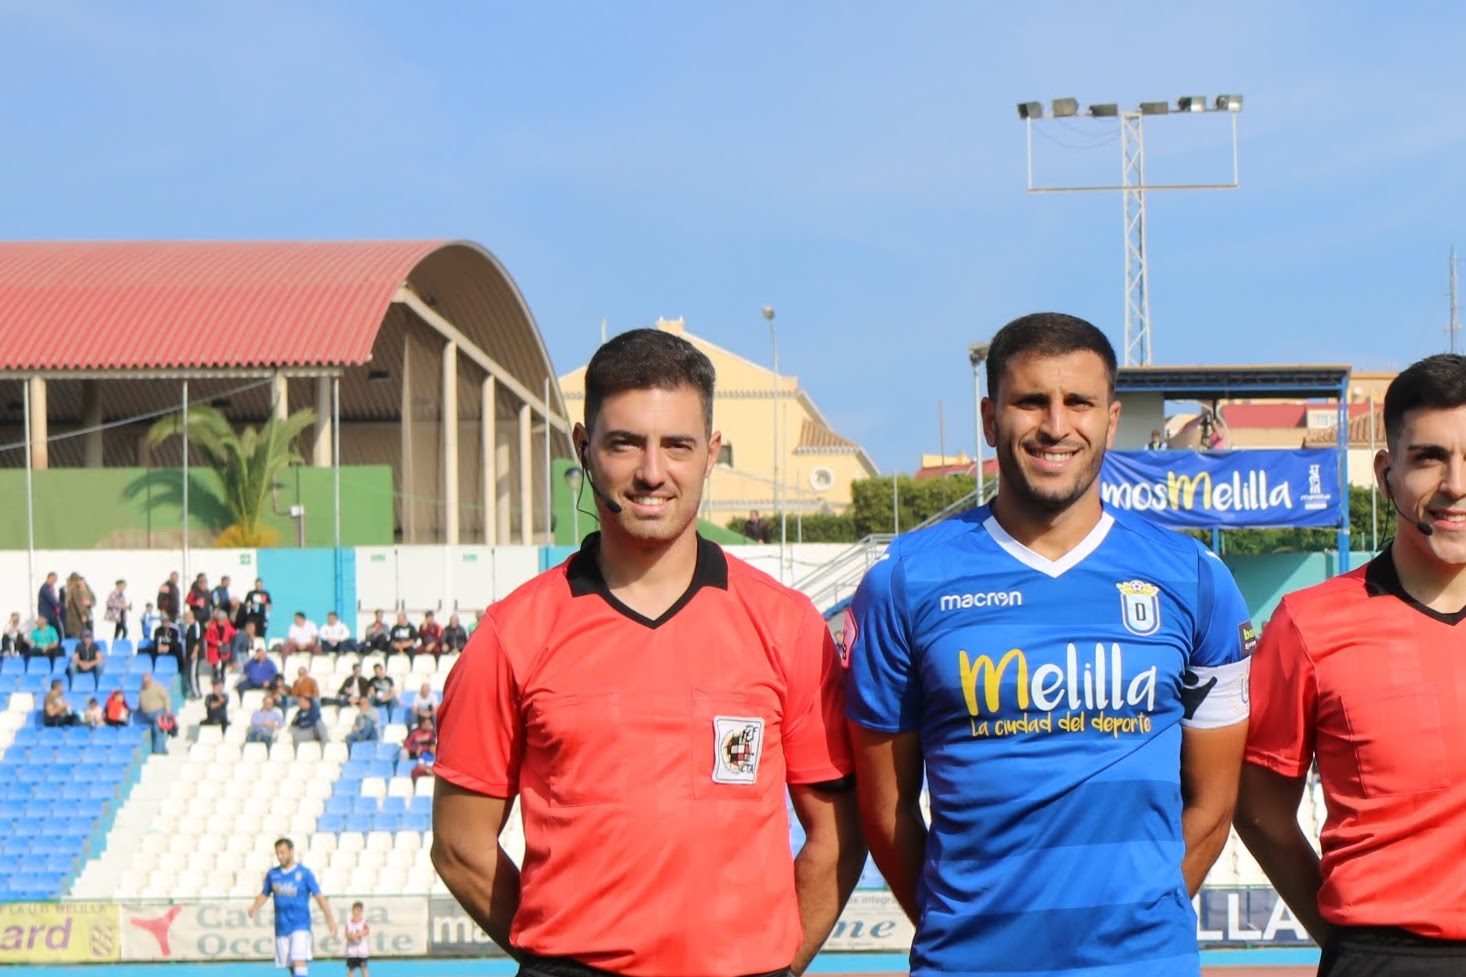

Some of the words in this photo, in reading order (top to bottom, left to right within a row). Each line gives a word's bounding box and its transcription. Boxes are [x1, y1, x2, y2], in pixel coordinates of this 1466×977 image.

[941, 590, 1022, 611] macron
[958, 642, 1156, 716] Melilla
[971, 716, 989, 737] La
[995, 713, 1052, 735] ciudad
[1058, 712, 1085, 732] del
[1091, 710, 1152, 739] deporte
